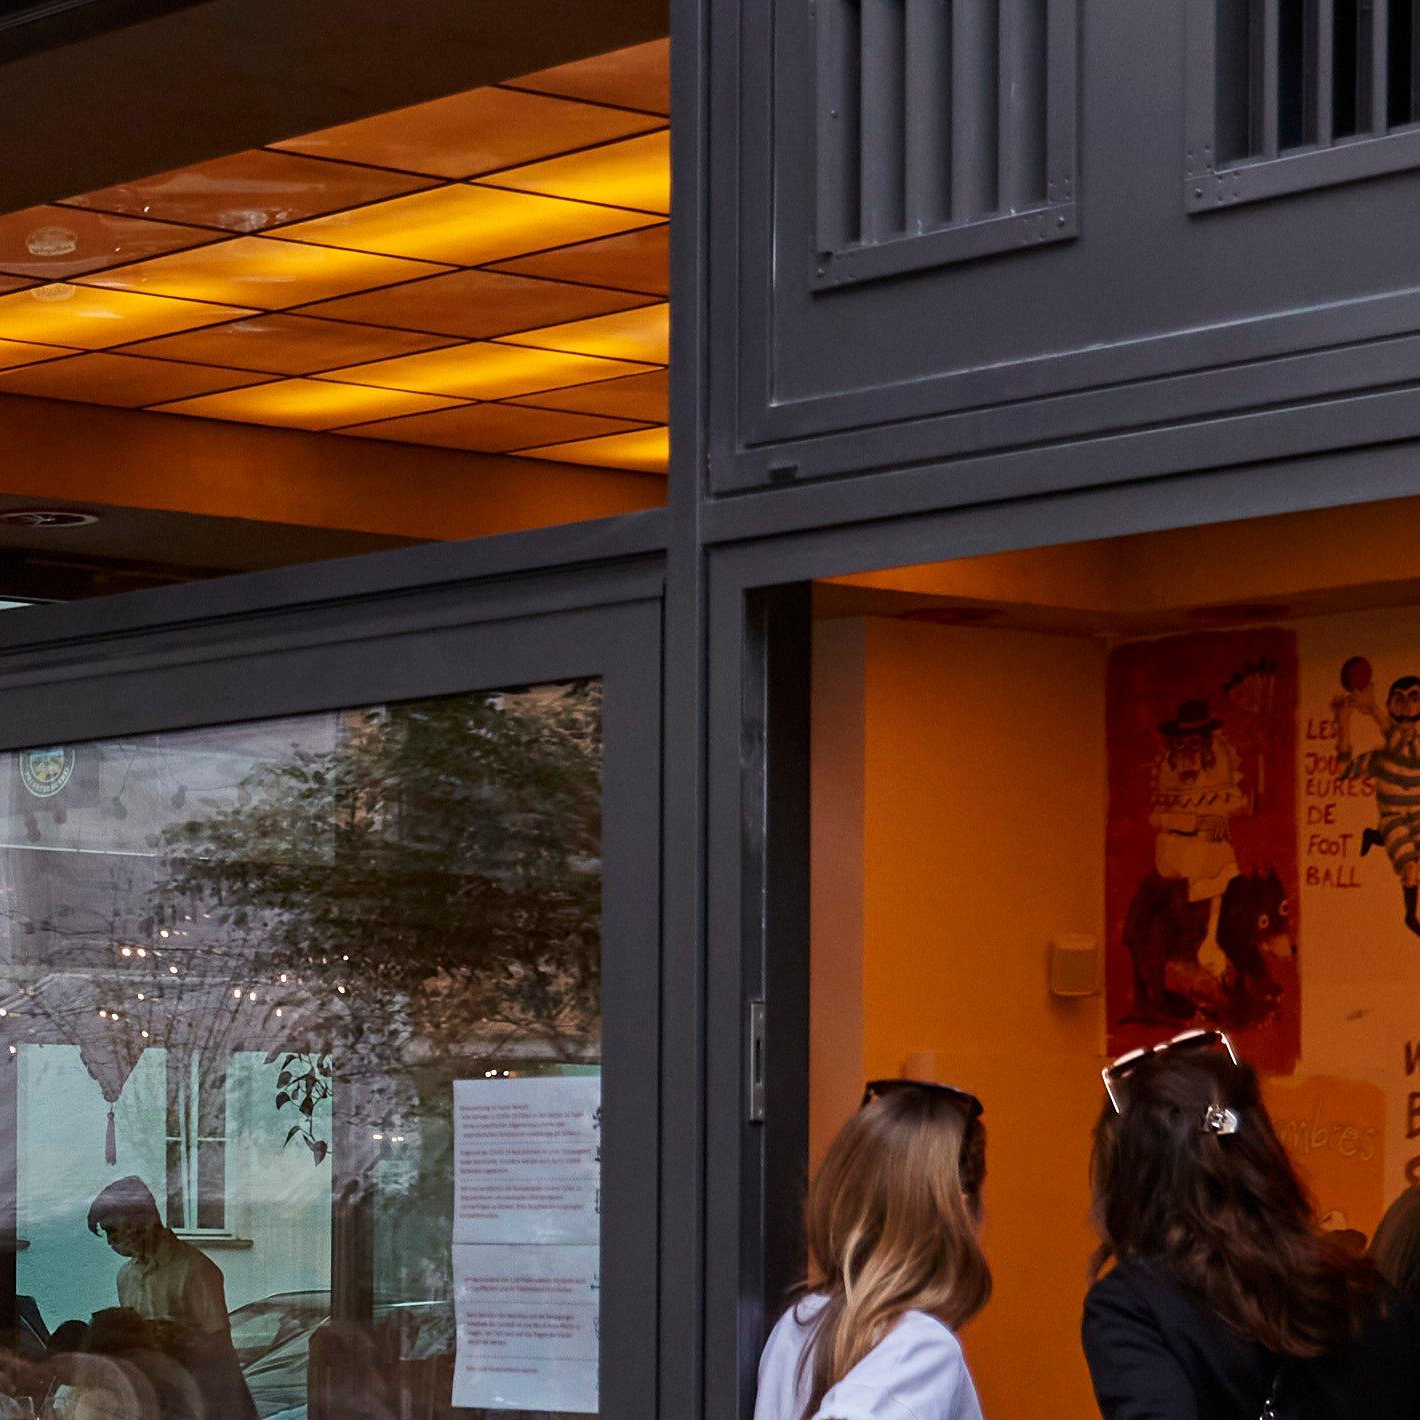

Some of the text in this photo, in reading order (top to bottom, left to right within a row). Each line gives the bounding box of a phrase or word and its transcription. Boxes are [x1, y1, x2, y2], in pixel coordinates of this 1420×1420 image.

[1307, 803, 1336, 825] DE
[1307, 833, 1353, 858] FOOT
[1306, 864, 1360, 888] BALL
